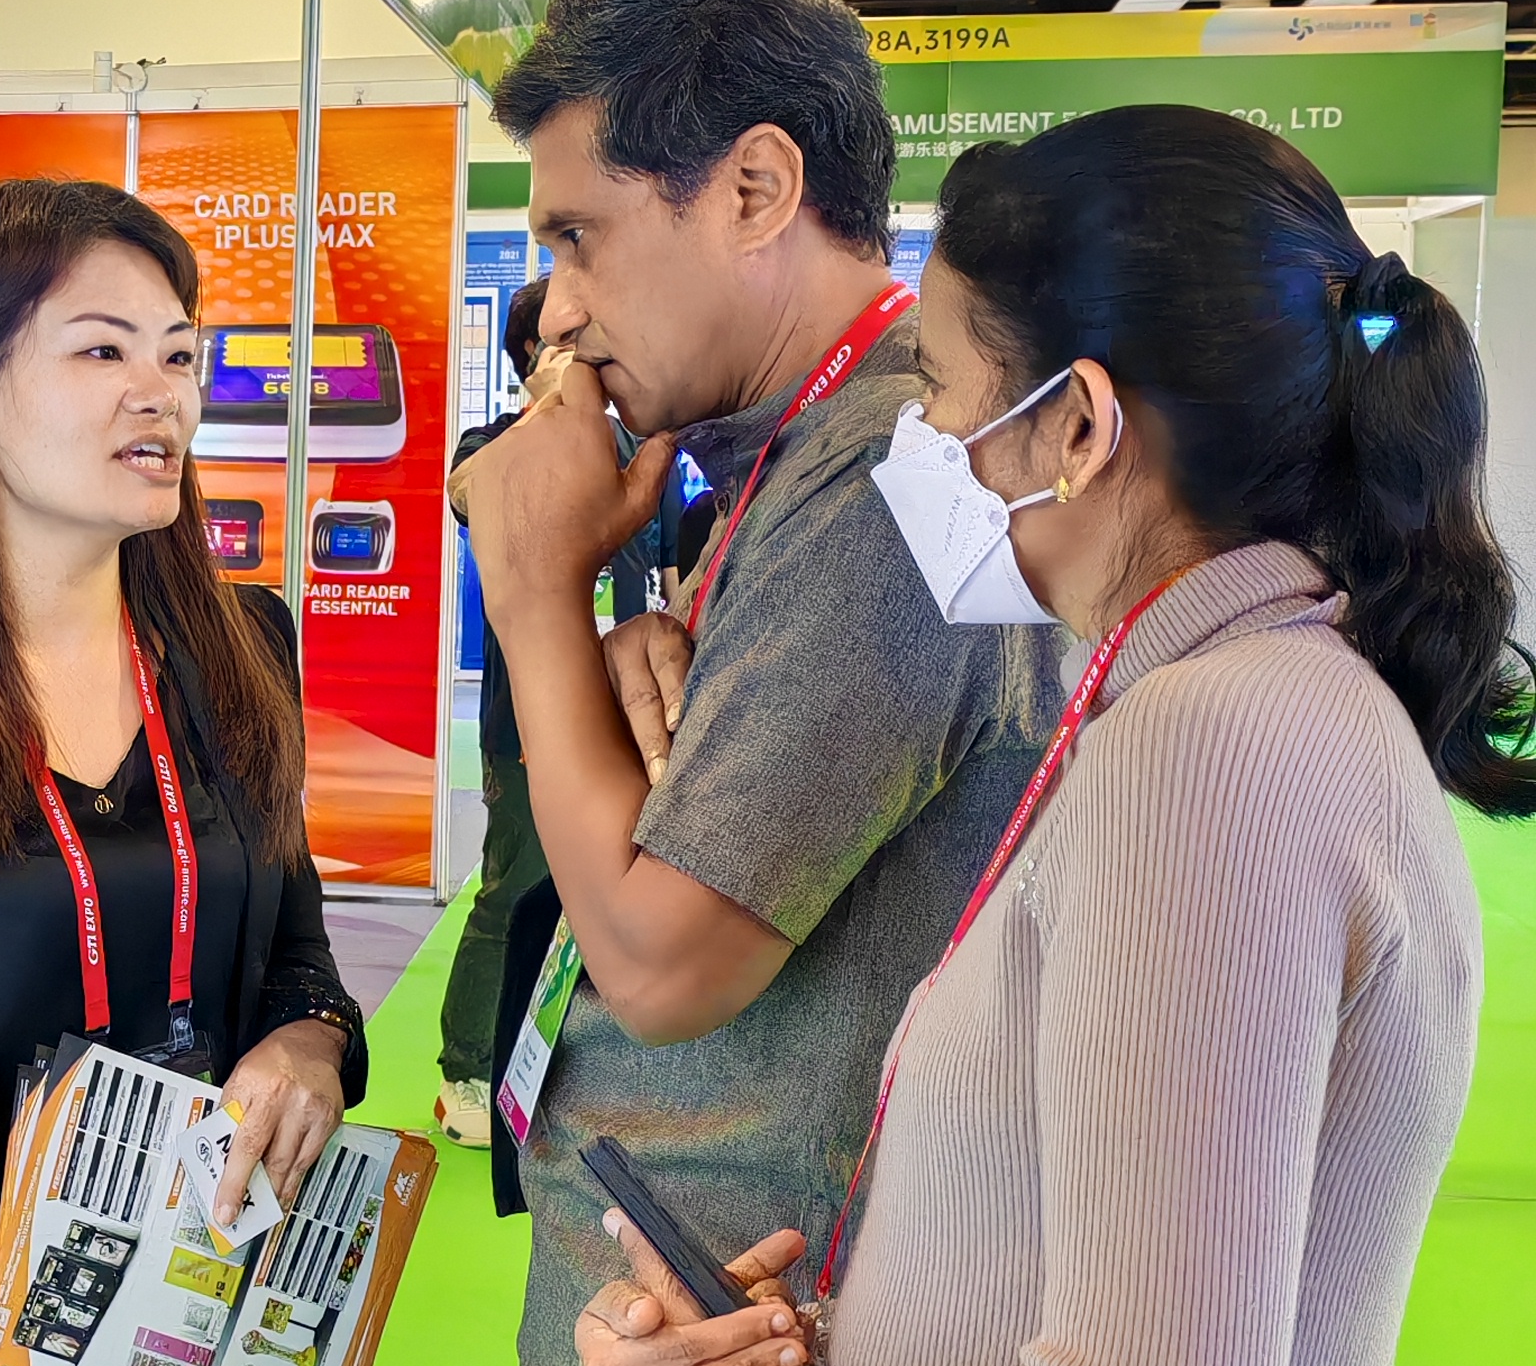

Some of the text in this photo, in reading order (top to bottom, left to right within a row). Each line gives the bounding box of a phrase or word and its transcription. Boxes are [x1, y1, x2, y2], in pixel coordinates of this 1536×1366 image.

[890, 110, 1055, 136] AMUSEMENT
[1291, 107, 1343, 129] LTD
[193, 191, 397, 218] CARD RADER
[316, 223, 375, 249] MAX
[799, 344, 852, 410] GTI EXPO
[347, 584, 410, 600] READER
[311, 599, 398, 616] ESSENTIAL
[1073, 666, 1099, 715] EXPO
[157, 753, 178, 813] GTI EXPO
[83, 898, 98, 965] GTI EXPO
